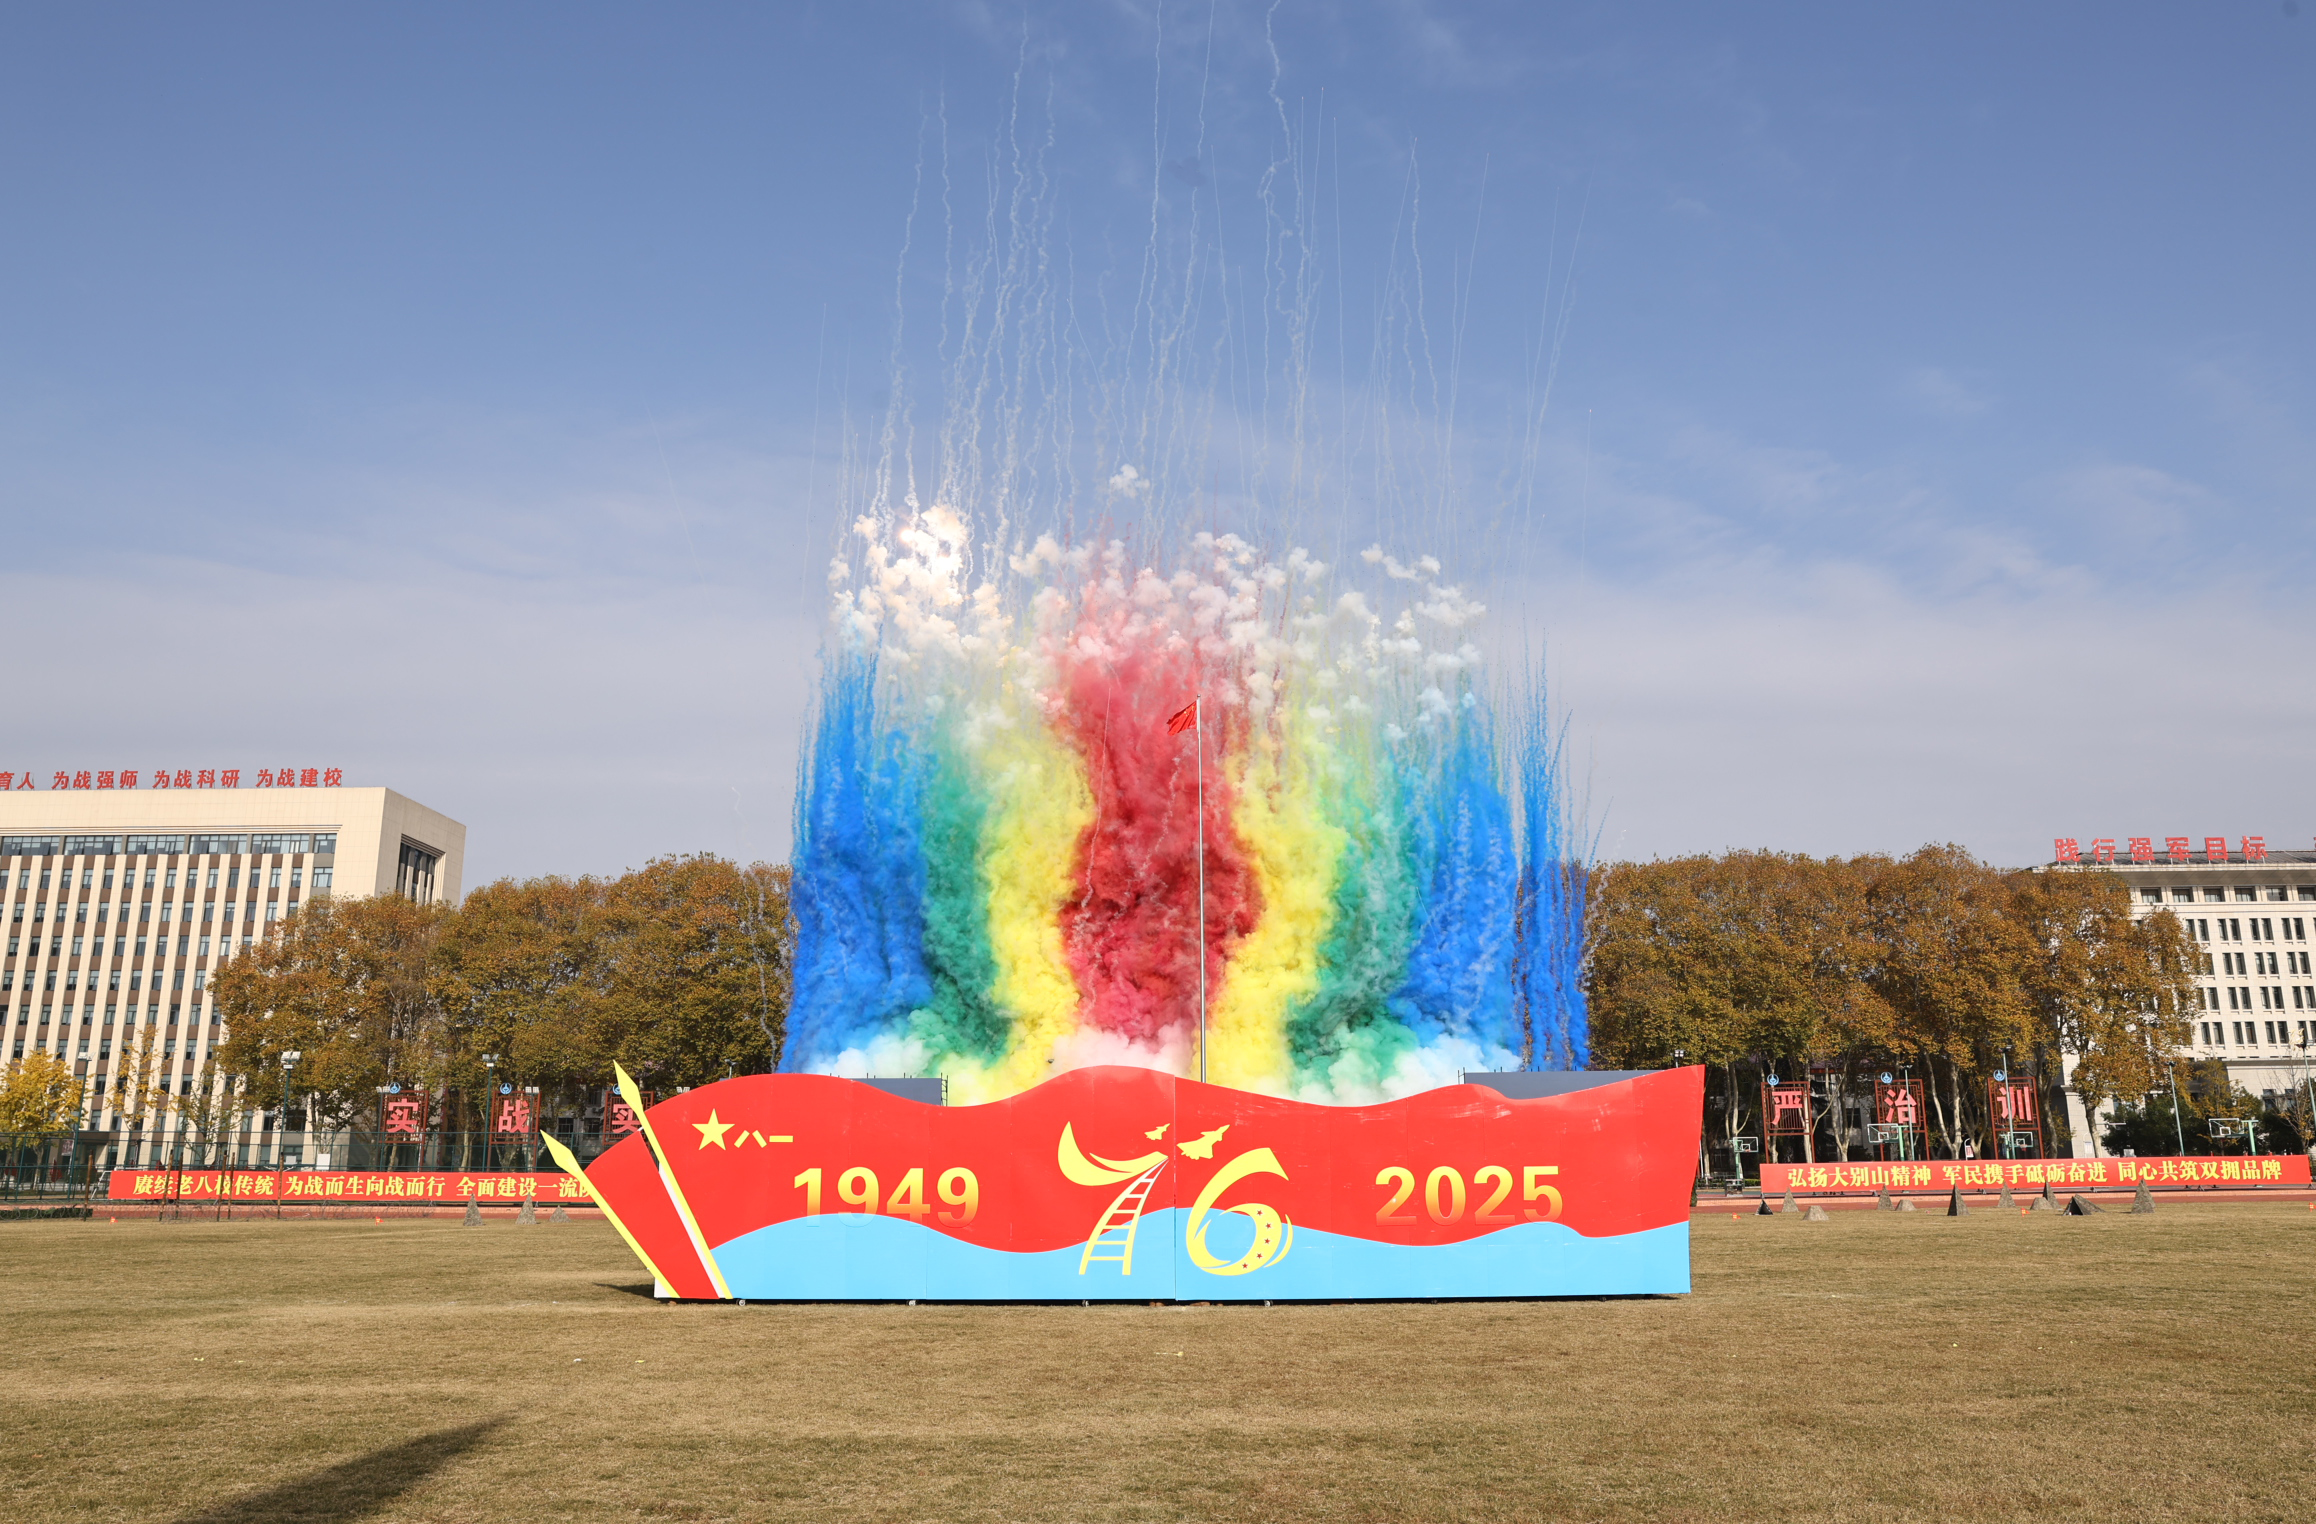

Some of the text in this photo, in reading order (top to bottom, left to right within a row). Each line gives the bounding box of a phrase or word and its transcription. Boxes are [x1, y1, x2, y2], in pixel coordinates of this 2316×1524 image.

[0, 767, 343, 790] 育人 为战强师 为战科研 为战建校
[2054, 835, 2269, 862] 践行强军目标
[386, 1098, 419, 1134] 实
[498, 1099, 530, 1134] 战
[1771, 1086, 2033, 1125] 严 治 训
[734, 1129, 794, 1148] 八一
[284, 1175, 446, 1196] 为战而生向战而行
[1787, 1159, 2282, 1188] 弘扬大别山精神 军民携手砥砺奋进 同心共筑双拥品牌
[794, 1166, 980, 1228] 1949
[1375, 1165, 1564, 1226] 2025
